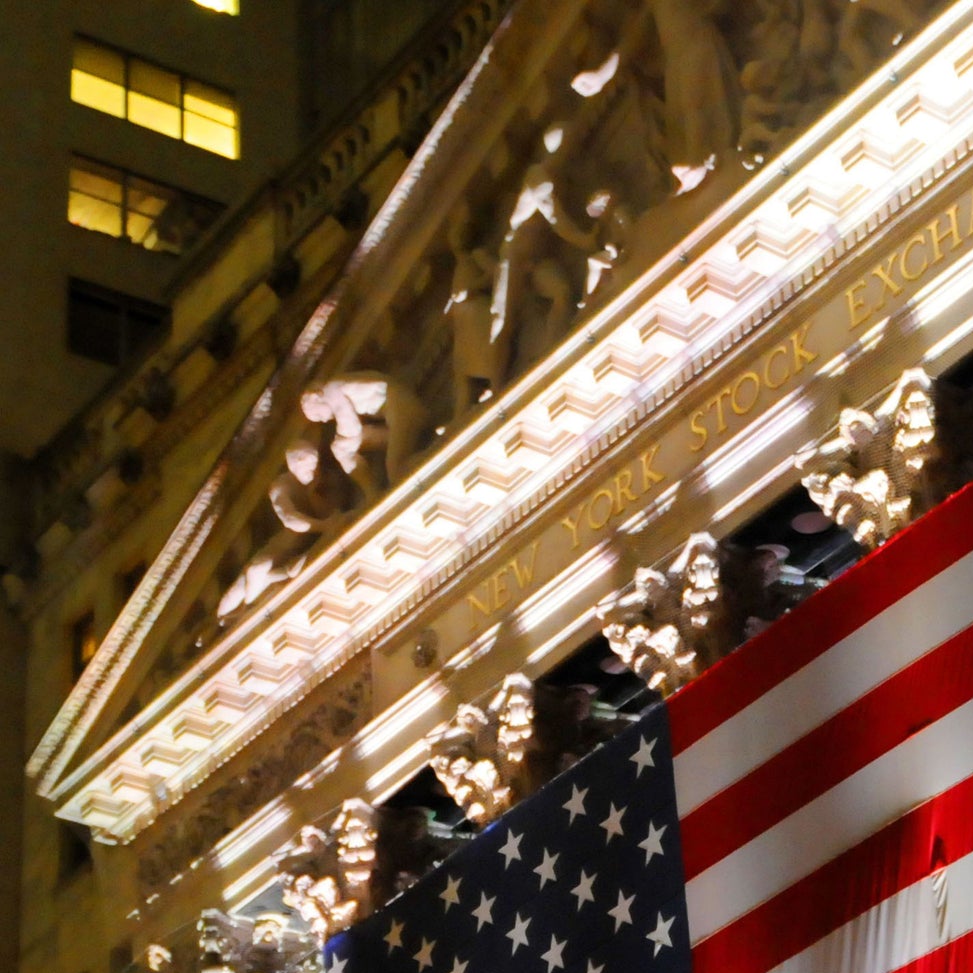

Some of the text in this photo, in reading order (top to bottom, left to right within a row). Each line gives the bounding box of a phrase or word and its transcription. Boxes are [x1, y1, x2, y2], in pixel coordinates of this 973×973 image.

[467, 538, 539, 632] NEW
[561, 445, 666, 549] YORK
[689, 322, 819, 452] STOCK
